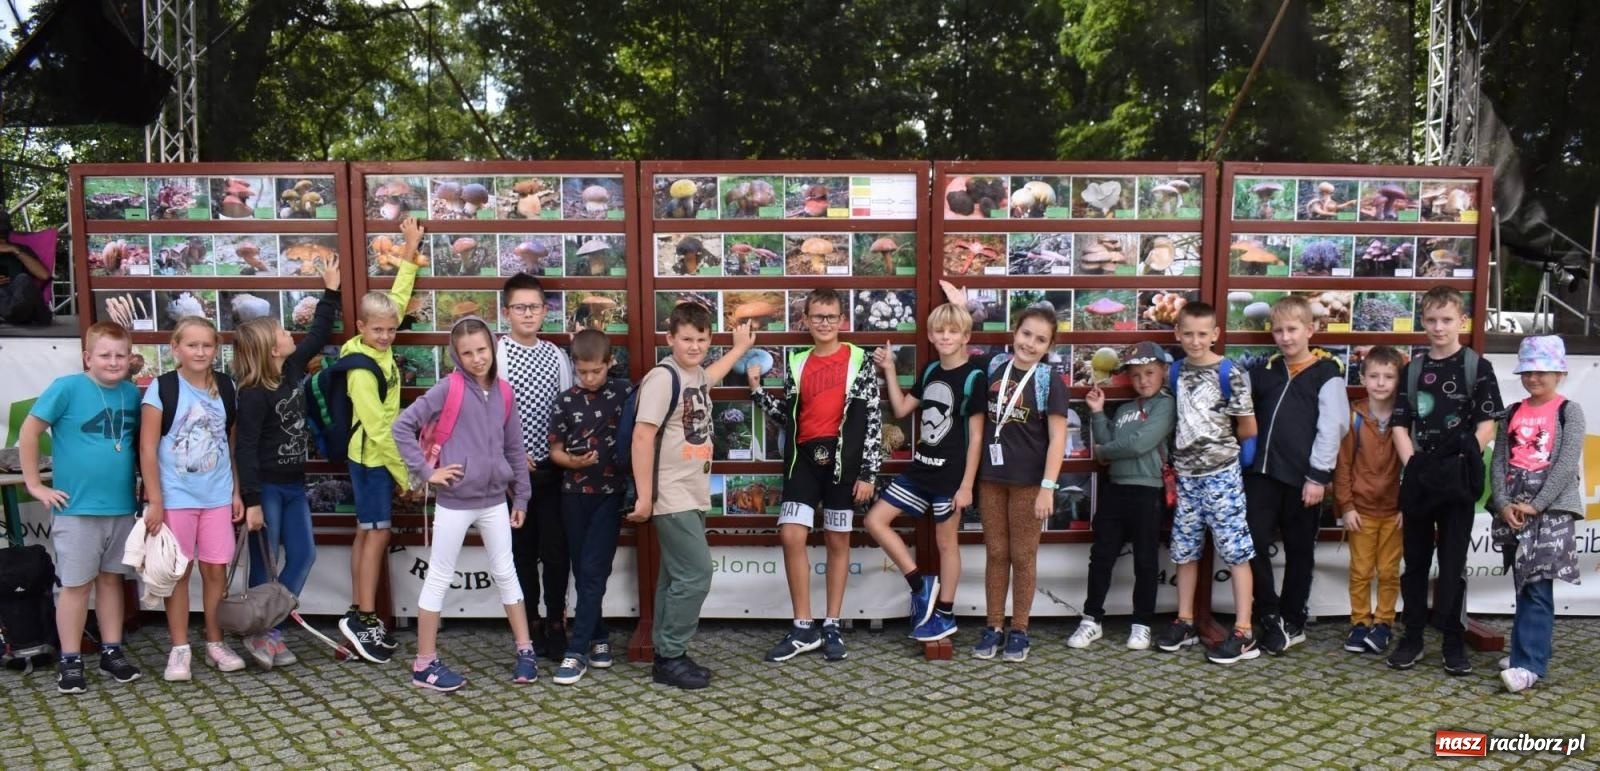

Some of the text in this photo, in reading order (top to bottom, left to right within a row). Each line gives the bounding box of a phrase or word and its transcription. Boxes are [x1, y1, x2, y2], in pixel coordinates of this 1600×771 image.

[81, 407, 140, 440] 4F
[782, 502, 801, 517] HAT
[712, 555, 776, 574] elona
